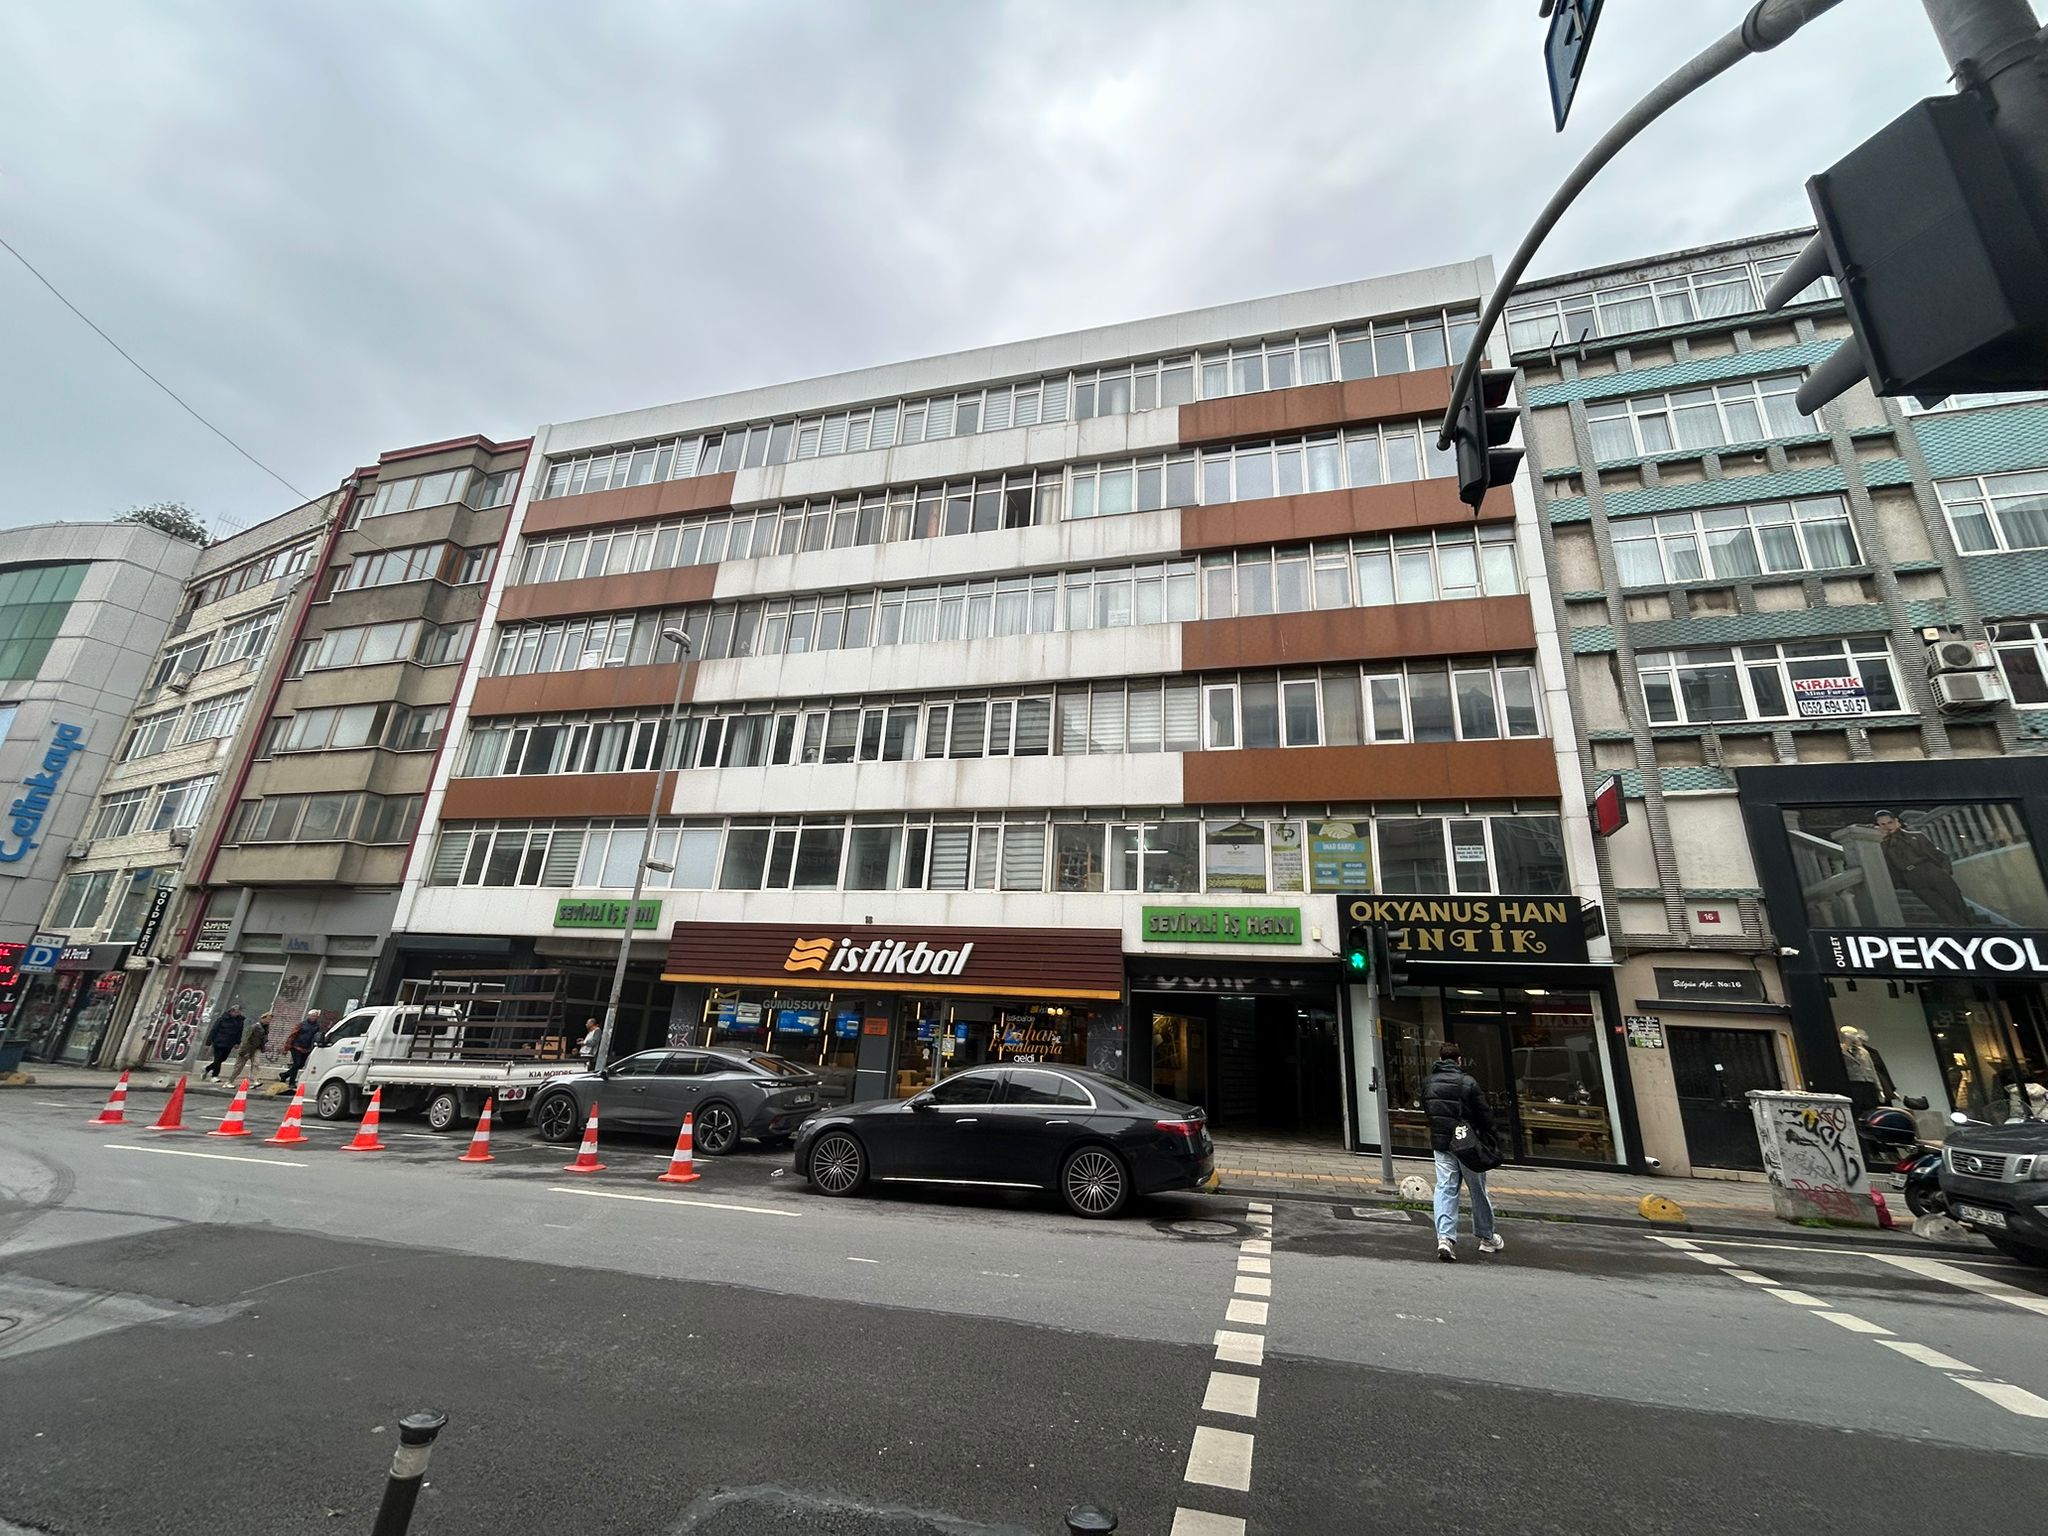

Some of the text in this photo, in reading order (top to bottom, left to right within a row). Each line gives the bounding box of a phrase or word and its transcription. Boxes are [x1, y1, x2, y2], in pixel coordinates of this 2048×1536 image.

[1801, 699, 1867, 714] 0552 694 50 57
[136, 891, 168, 956] GOLD PERUK
[1149, 911, 1295, 938] SEVİMLİ İŞ HANI
[1350, 901, 1568, 924] OKYANUS HAN
[1703, 913, 1714, 921] 16
[828, 937, 975, 976] istikbal
[1830, 936, 2048, 972] OUTLET IPEKYOL
